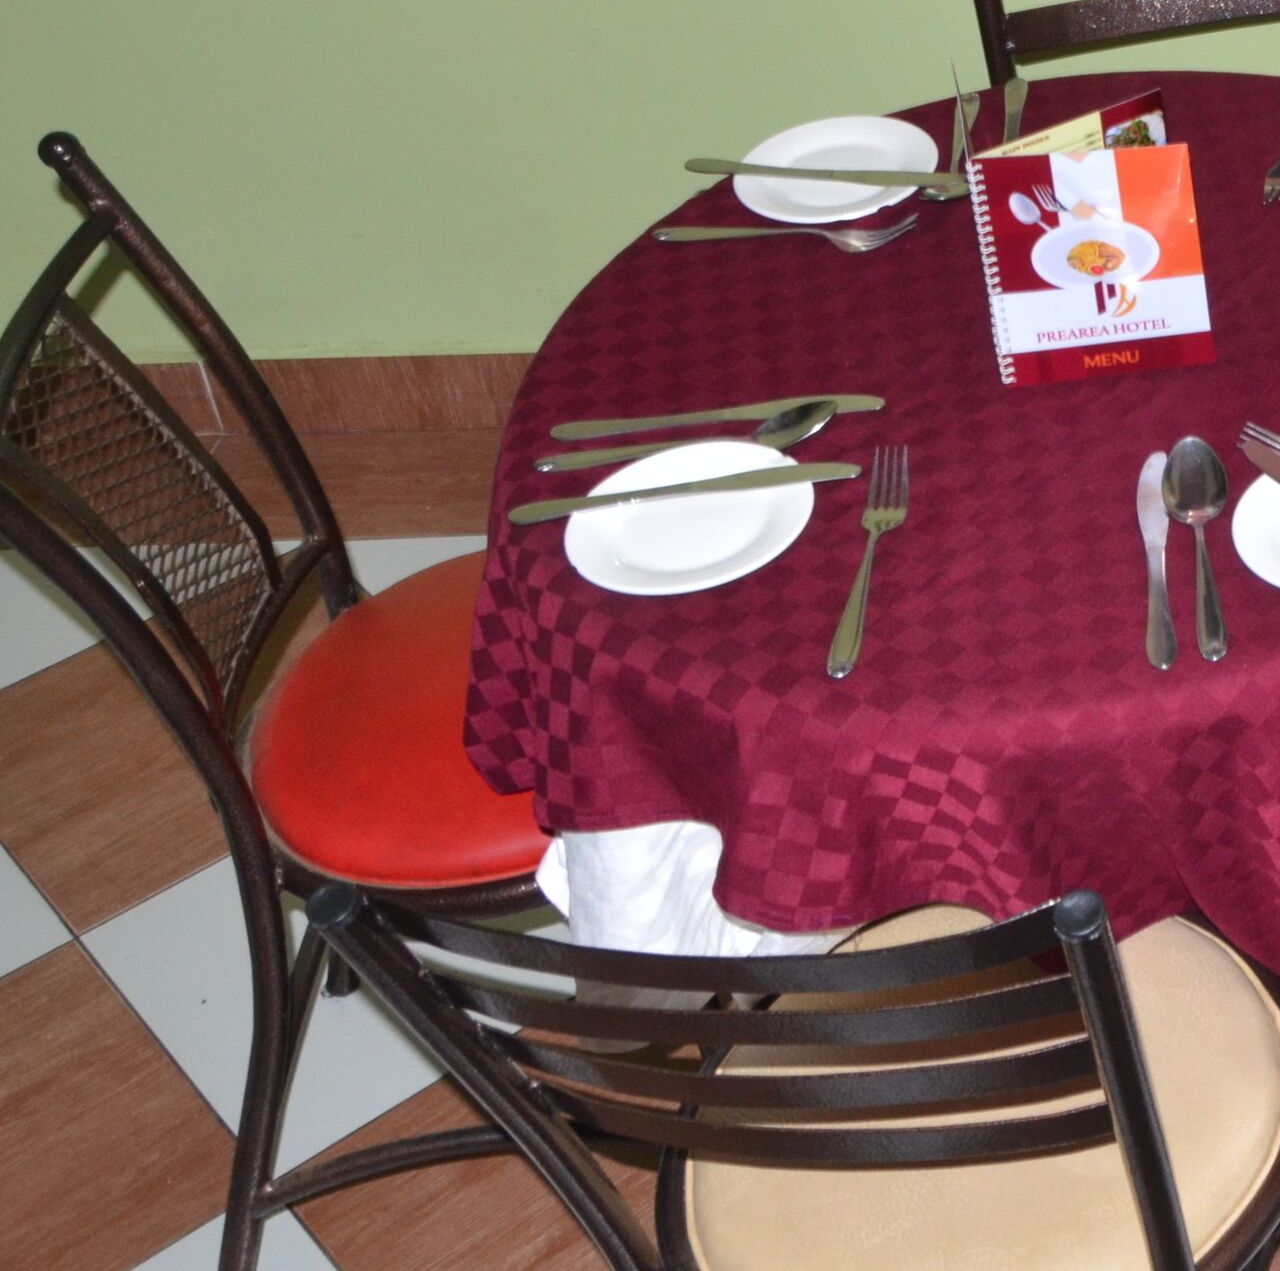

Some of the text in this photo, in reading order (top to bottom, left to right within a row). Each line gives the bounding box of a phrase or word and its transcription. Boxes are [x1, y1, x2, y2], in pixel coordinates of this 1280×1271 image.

[1036, 318, 1171, 343] PREAREA HOTEL
[1083, 350, 1140, 368] MENU
